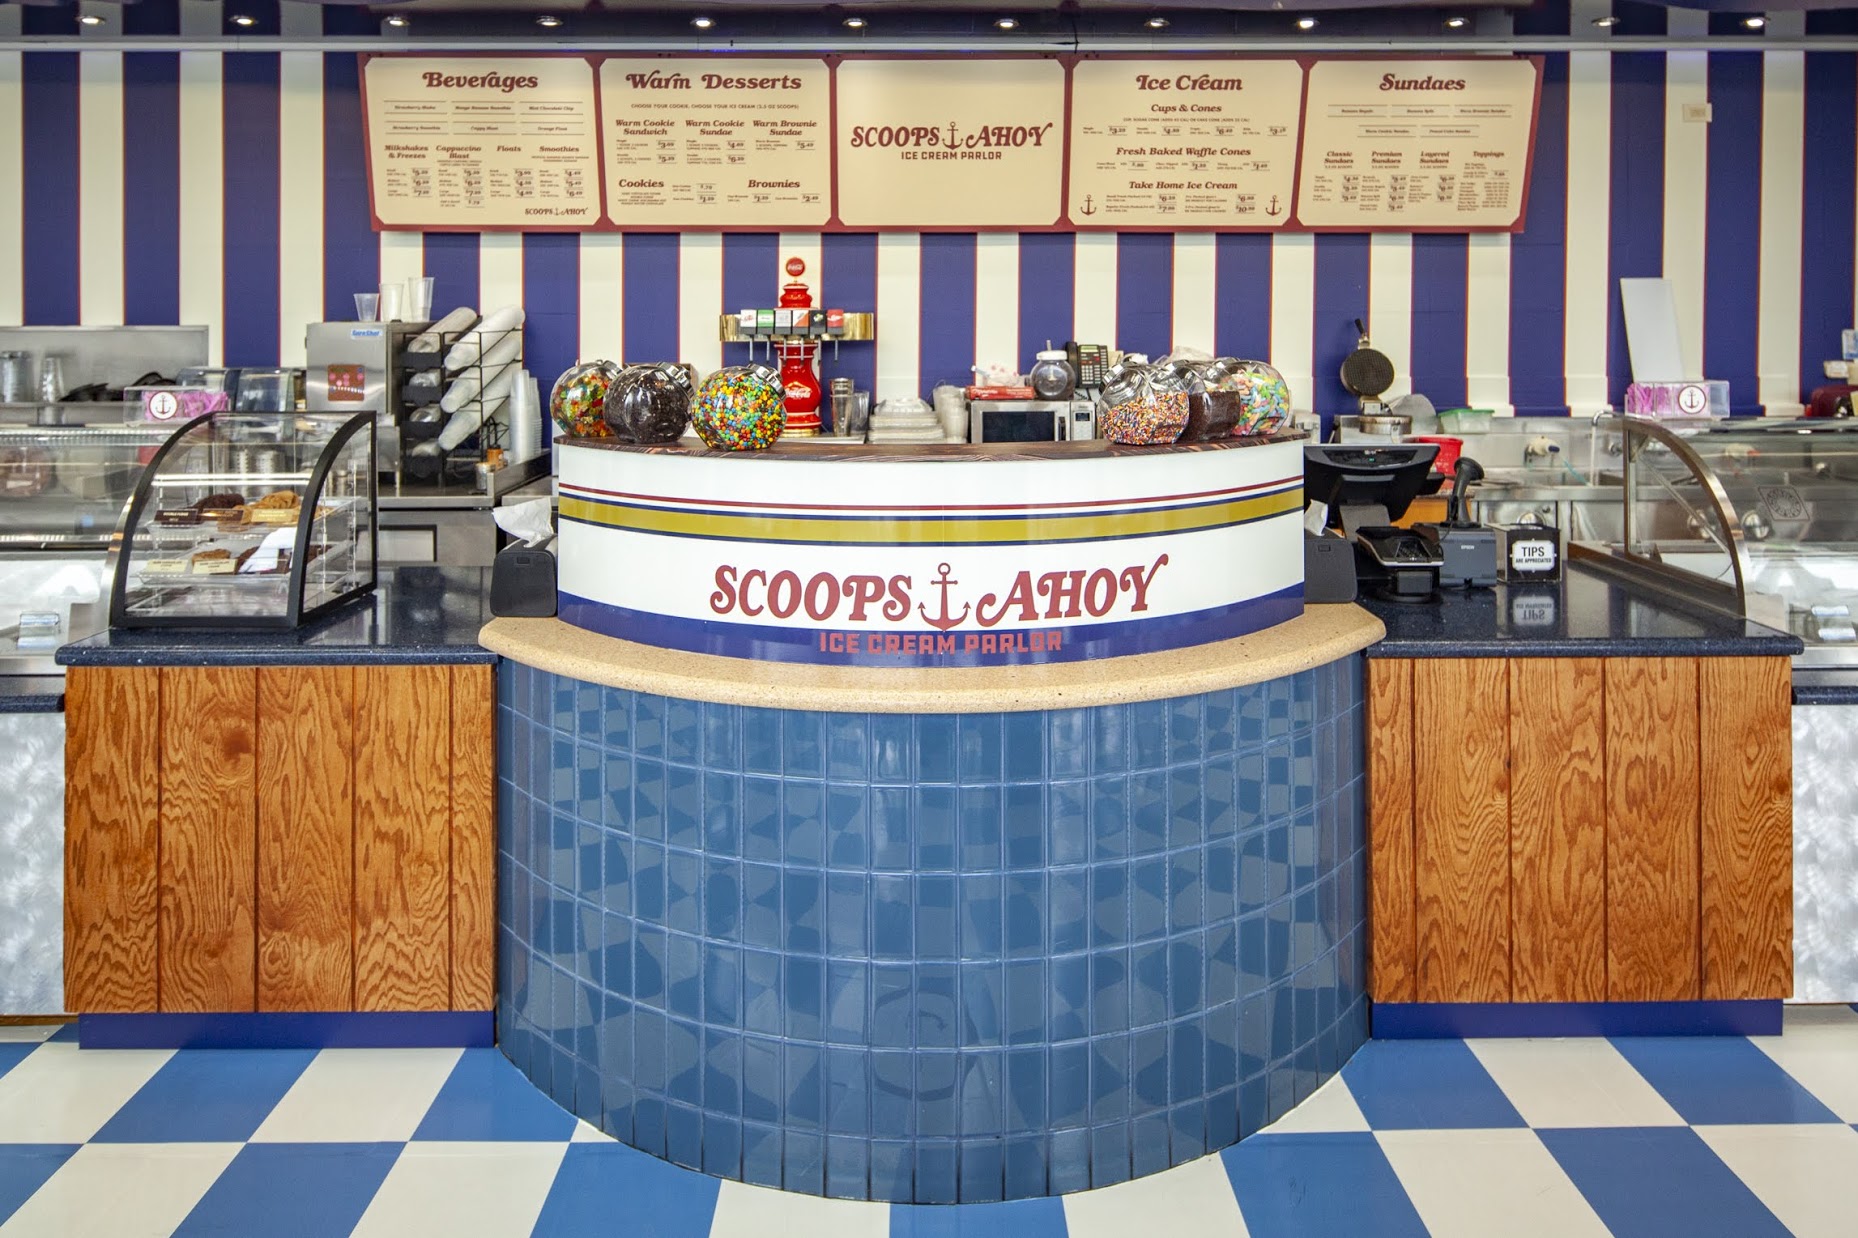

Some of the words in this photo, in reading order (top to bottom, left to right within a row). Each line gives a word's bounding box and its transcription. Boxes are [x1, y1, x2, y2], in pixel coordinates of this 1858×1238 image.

[422, 72, 538, 93] Beverages
[626, 70, 691, 89] Warm
[701, 74, 802, 89] Desserts
[1136, 74, 1170, 90] Ice
[1176, 74, 1242, 90] Cream
[1380, 73, 1466, 90] Sundaes
[1151, 104, 1176, 113] Cups
[851, 126, 940, 148] SCOOPS
[966, 122, 1053, 148] AHOY
[1186, 148, 1217, 157] Waffle
[619, 179, 664, 188] Cookies
[748, 180, 800, 188] Brownies
[1522, 546, 1544, 557] TIPS
[710, 564, 912, 622] SCOOPS
[975, 554, 1169, 627] AHOY
[820, 632, 860, 654] ICE
[867, 634, 956, 655] CREAM
[964, 631, 1062, 654] PARLOR
